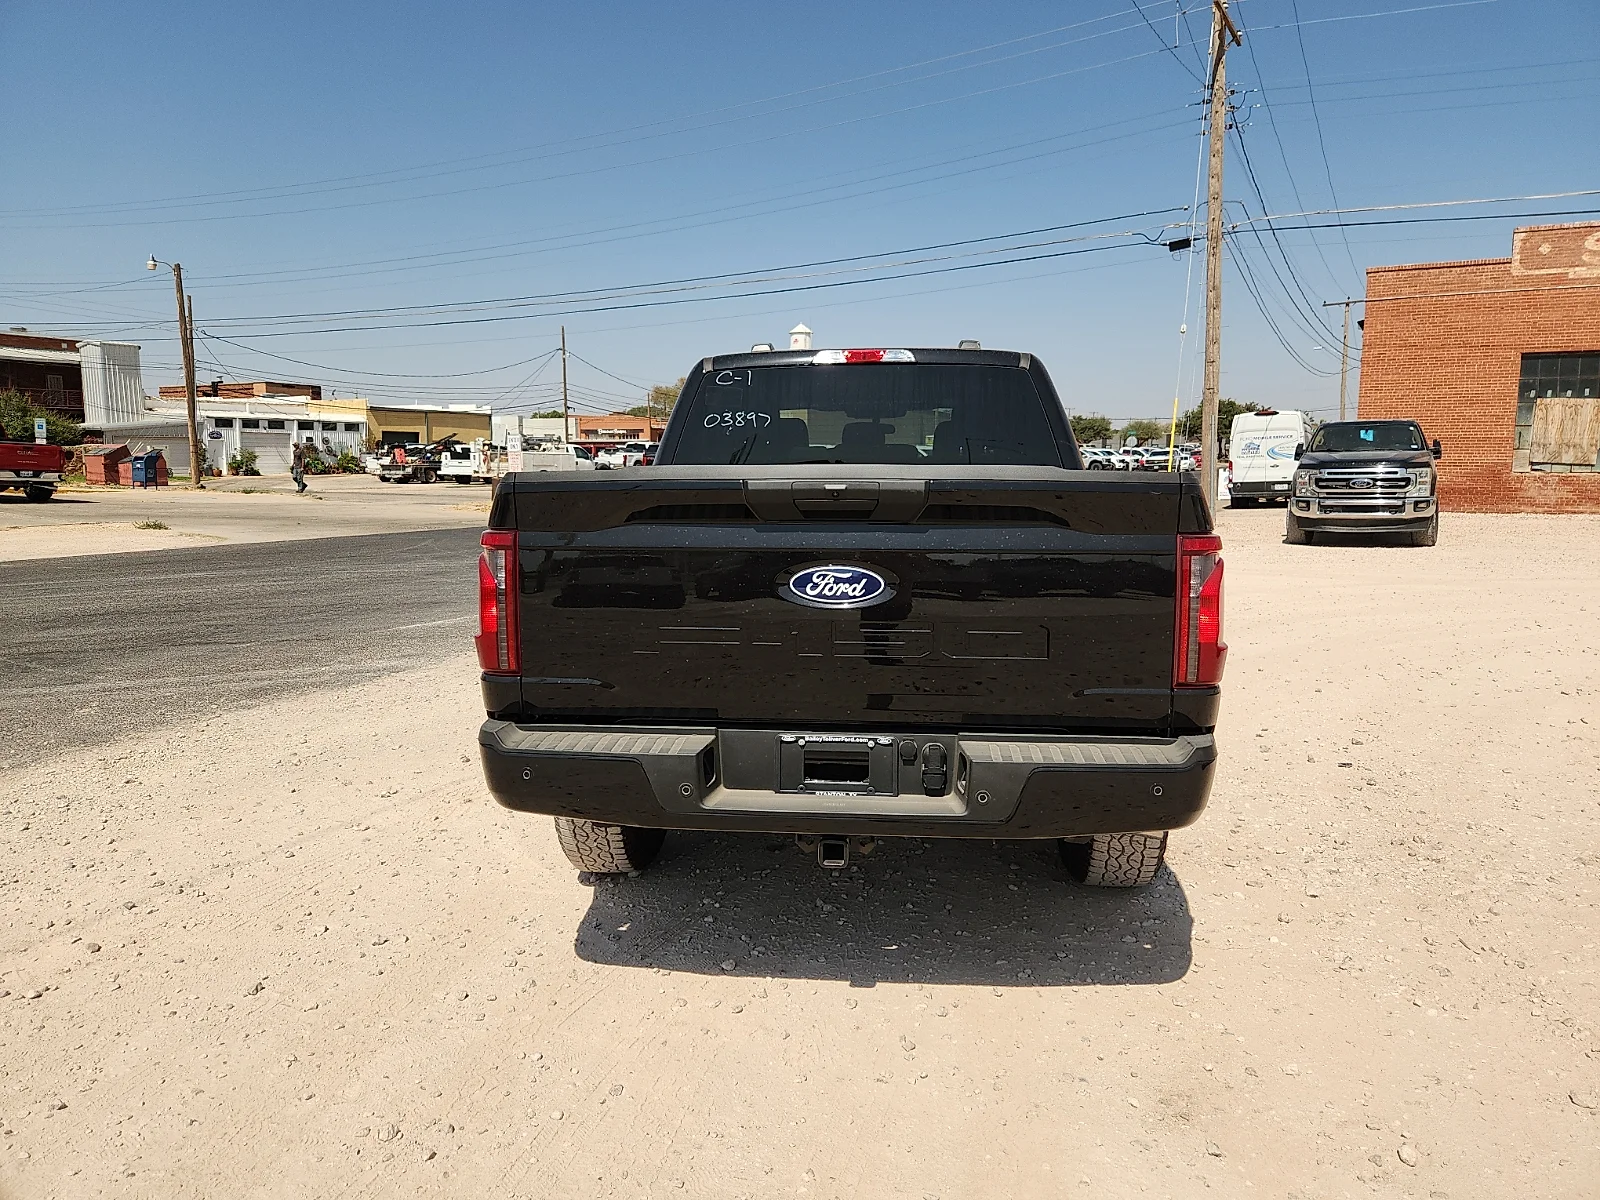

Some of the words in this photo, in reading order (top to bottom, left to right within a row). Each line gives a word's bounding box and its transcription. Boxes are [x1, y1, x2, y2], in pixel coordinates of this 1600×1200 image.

[716, 370, 752, 386] C-1
[704, 412, 771, 428] 03897
[806, 571, 867, 596] Ford
